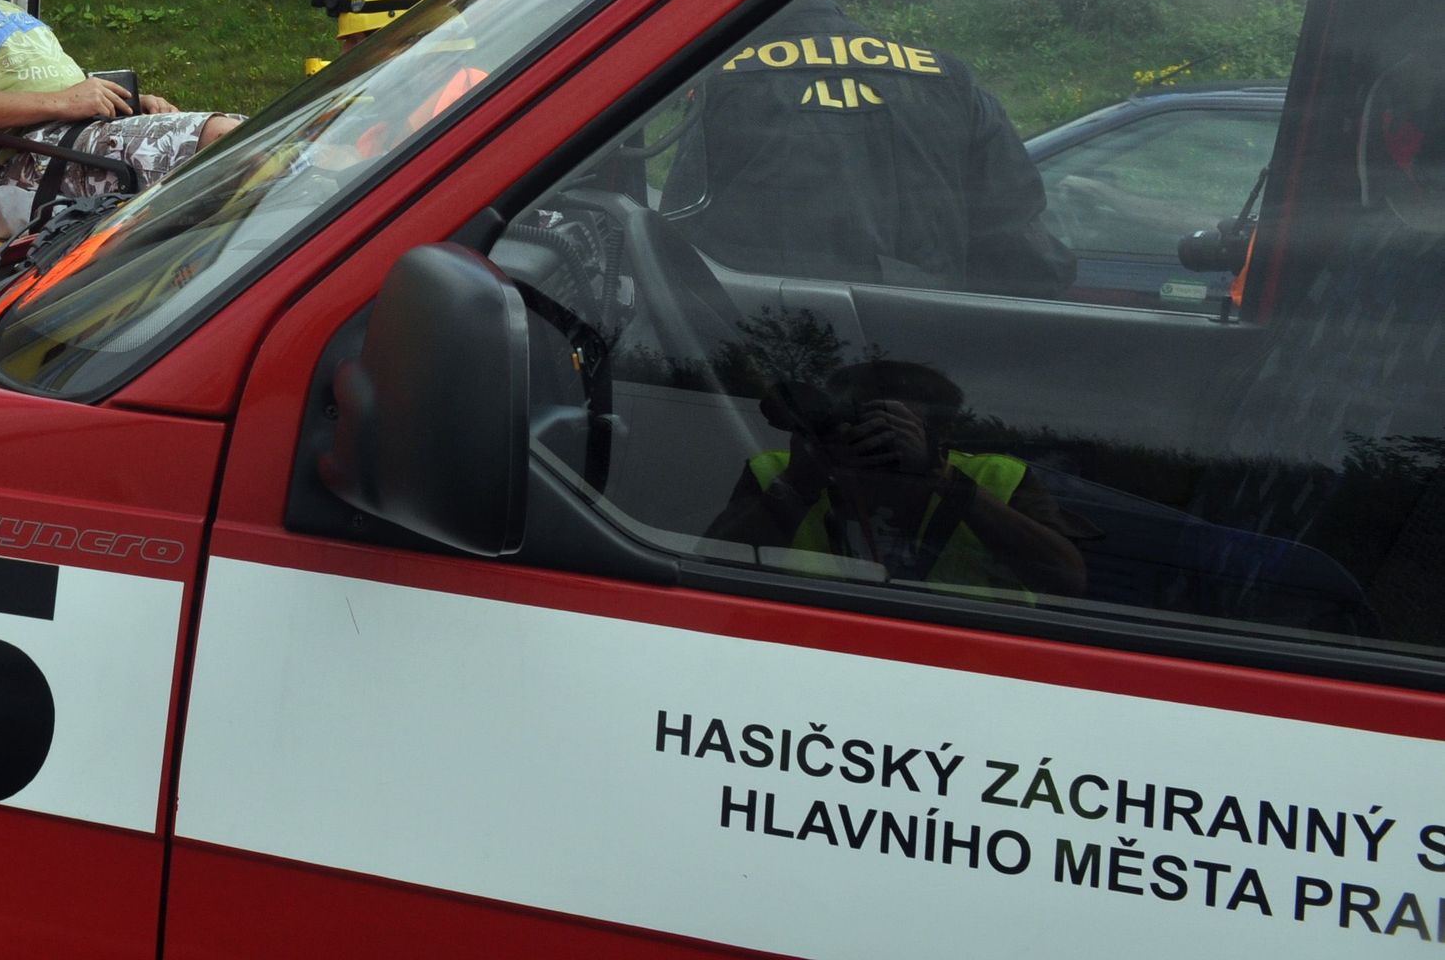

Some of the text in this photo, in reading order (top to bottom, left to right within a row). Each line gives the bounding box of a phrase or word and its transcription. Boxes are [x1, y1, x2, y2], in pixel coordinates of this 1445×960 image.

[655, 710, 965, 797] HASIČSKÝ
[981, 757, 1396, 863] ZÁCHRANNÝ
[720, 785, 1445, 944] HLAVNÍHO MĚSTA PRA
